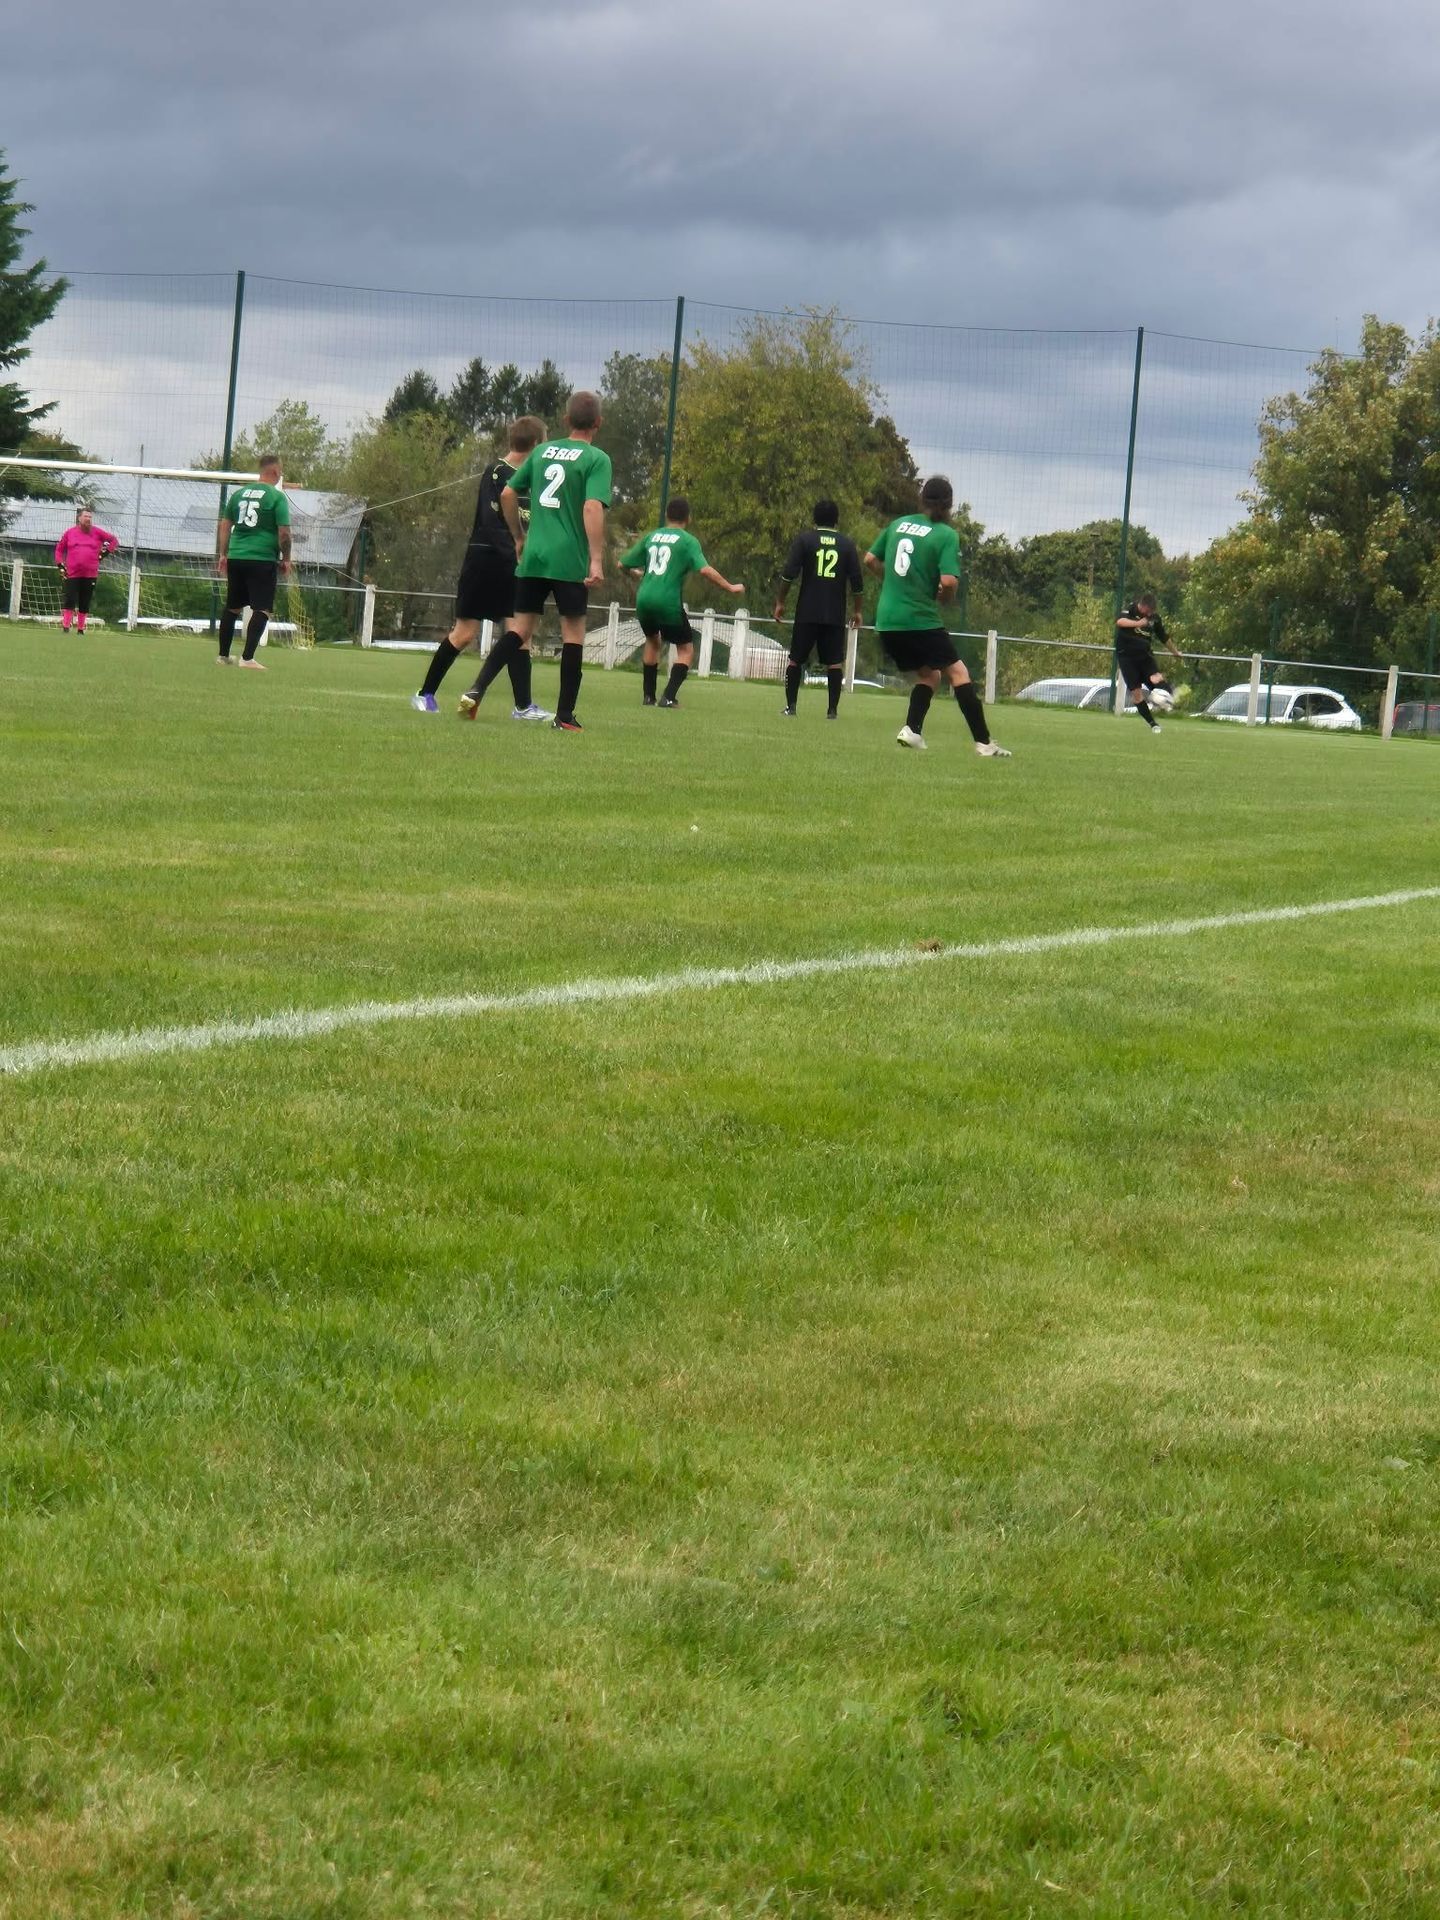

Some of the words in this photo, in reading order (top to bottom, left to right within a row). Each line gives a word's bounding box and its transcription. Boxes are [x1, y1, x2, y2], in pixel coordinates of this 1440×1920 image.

[539, 463, 566, 509] 2
[238, 500, 260, 527] 15
[816, 549, 839, 578] 12
[894, 538, 915, 577] 6
